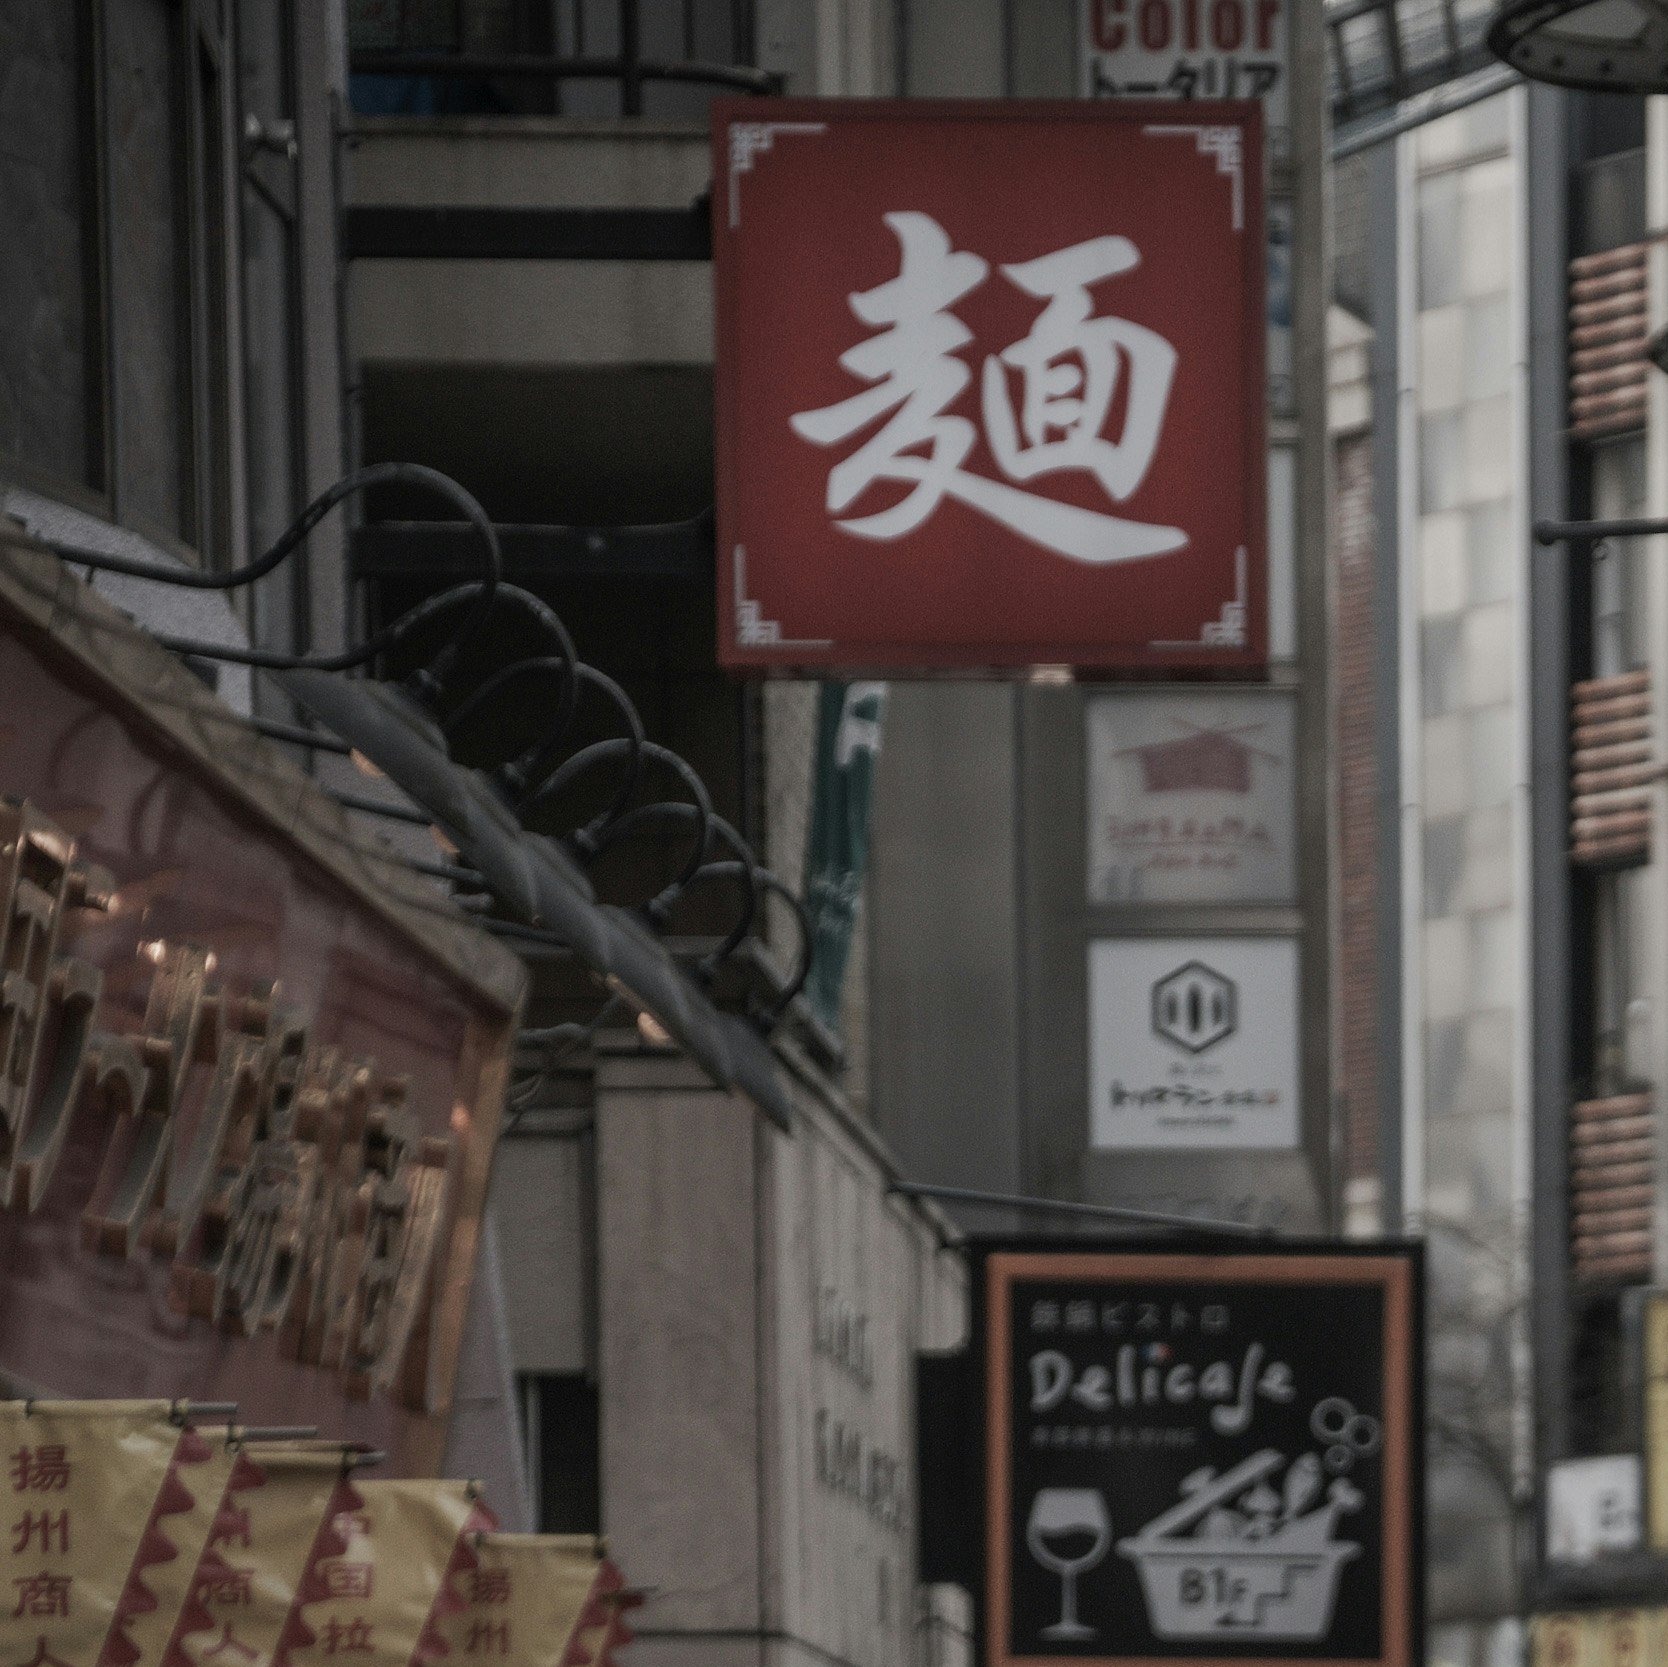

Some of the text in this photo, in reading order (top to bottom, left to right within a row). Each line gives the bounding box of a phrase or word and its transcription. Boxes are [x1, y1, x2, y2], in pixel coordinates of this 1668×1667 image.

[1091, 0, 1280, 51] Color
[789, 210, 1190, 566] 麺
[1178, 1566, 1249, 1608] B1F
